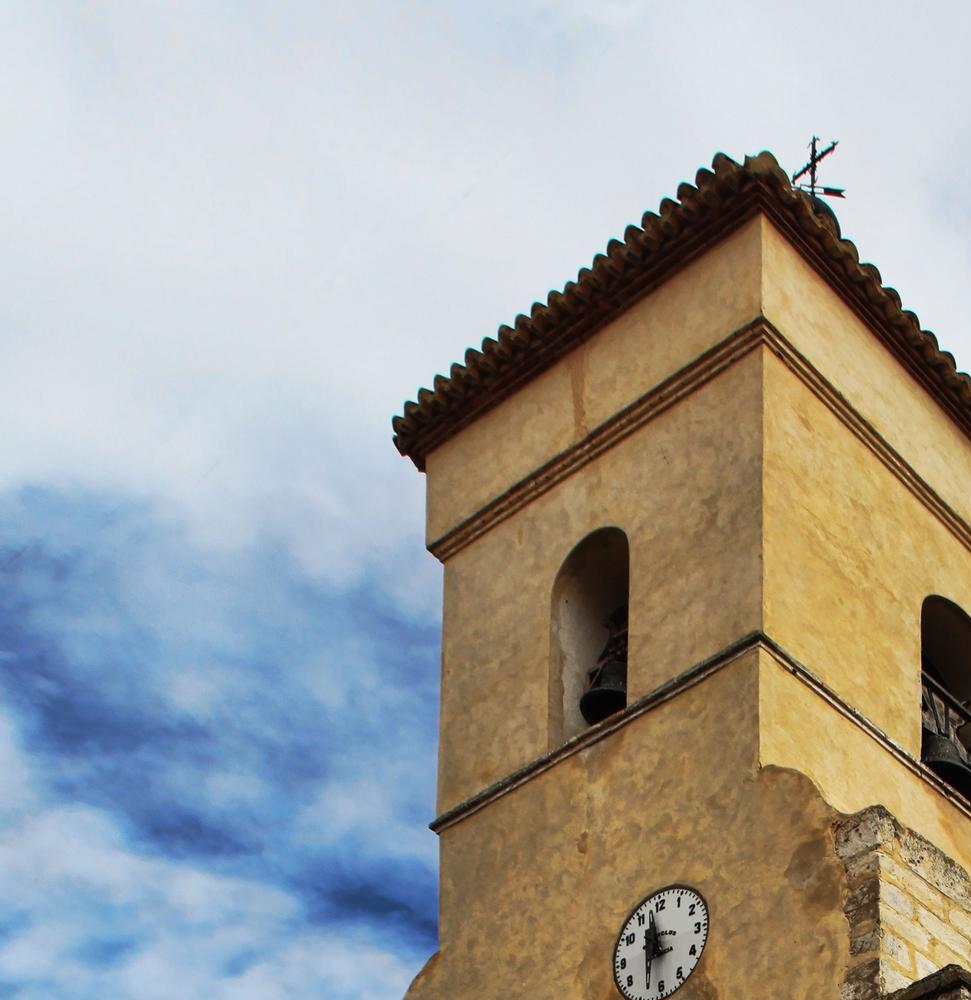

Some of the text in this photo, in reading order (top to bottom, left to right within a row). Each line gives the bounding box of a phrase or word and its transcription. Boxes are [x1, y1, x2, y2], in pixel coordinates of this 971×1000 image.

[655, 899, 666, 912] 12
[677, 897, 681, 908] 1
[689, 904, 696, 916] 2
[638, 914, 645, 926] 11
[694, 922, 701, 934] 3
[626, 933, 635, 946] 10
[689, 944, 697, 956] 4
[620, 958, 626, 969] 9
[676, 967, 682, 979] 5
[627, 975, 633, 987] 8
[658, 981, 664, 992] 6
